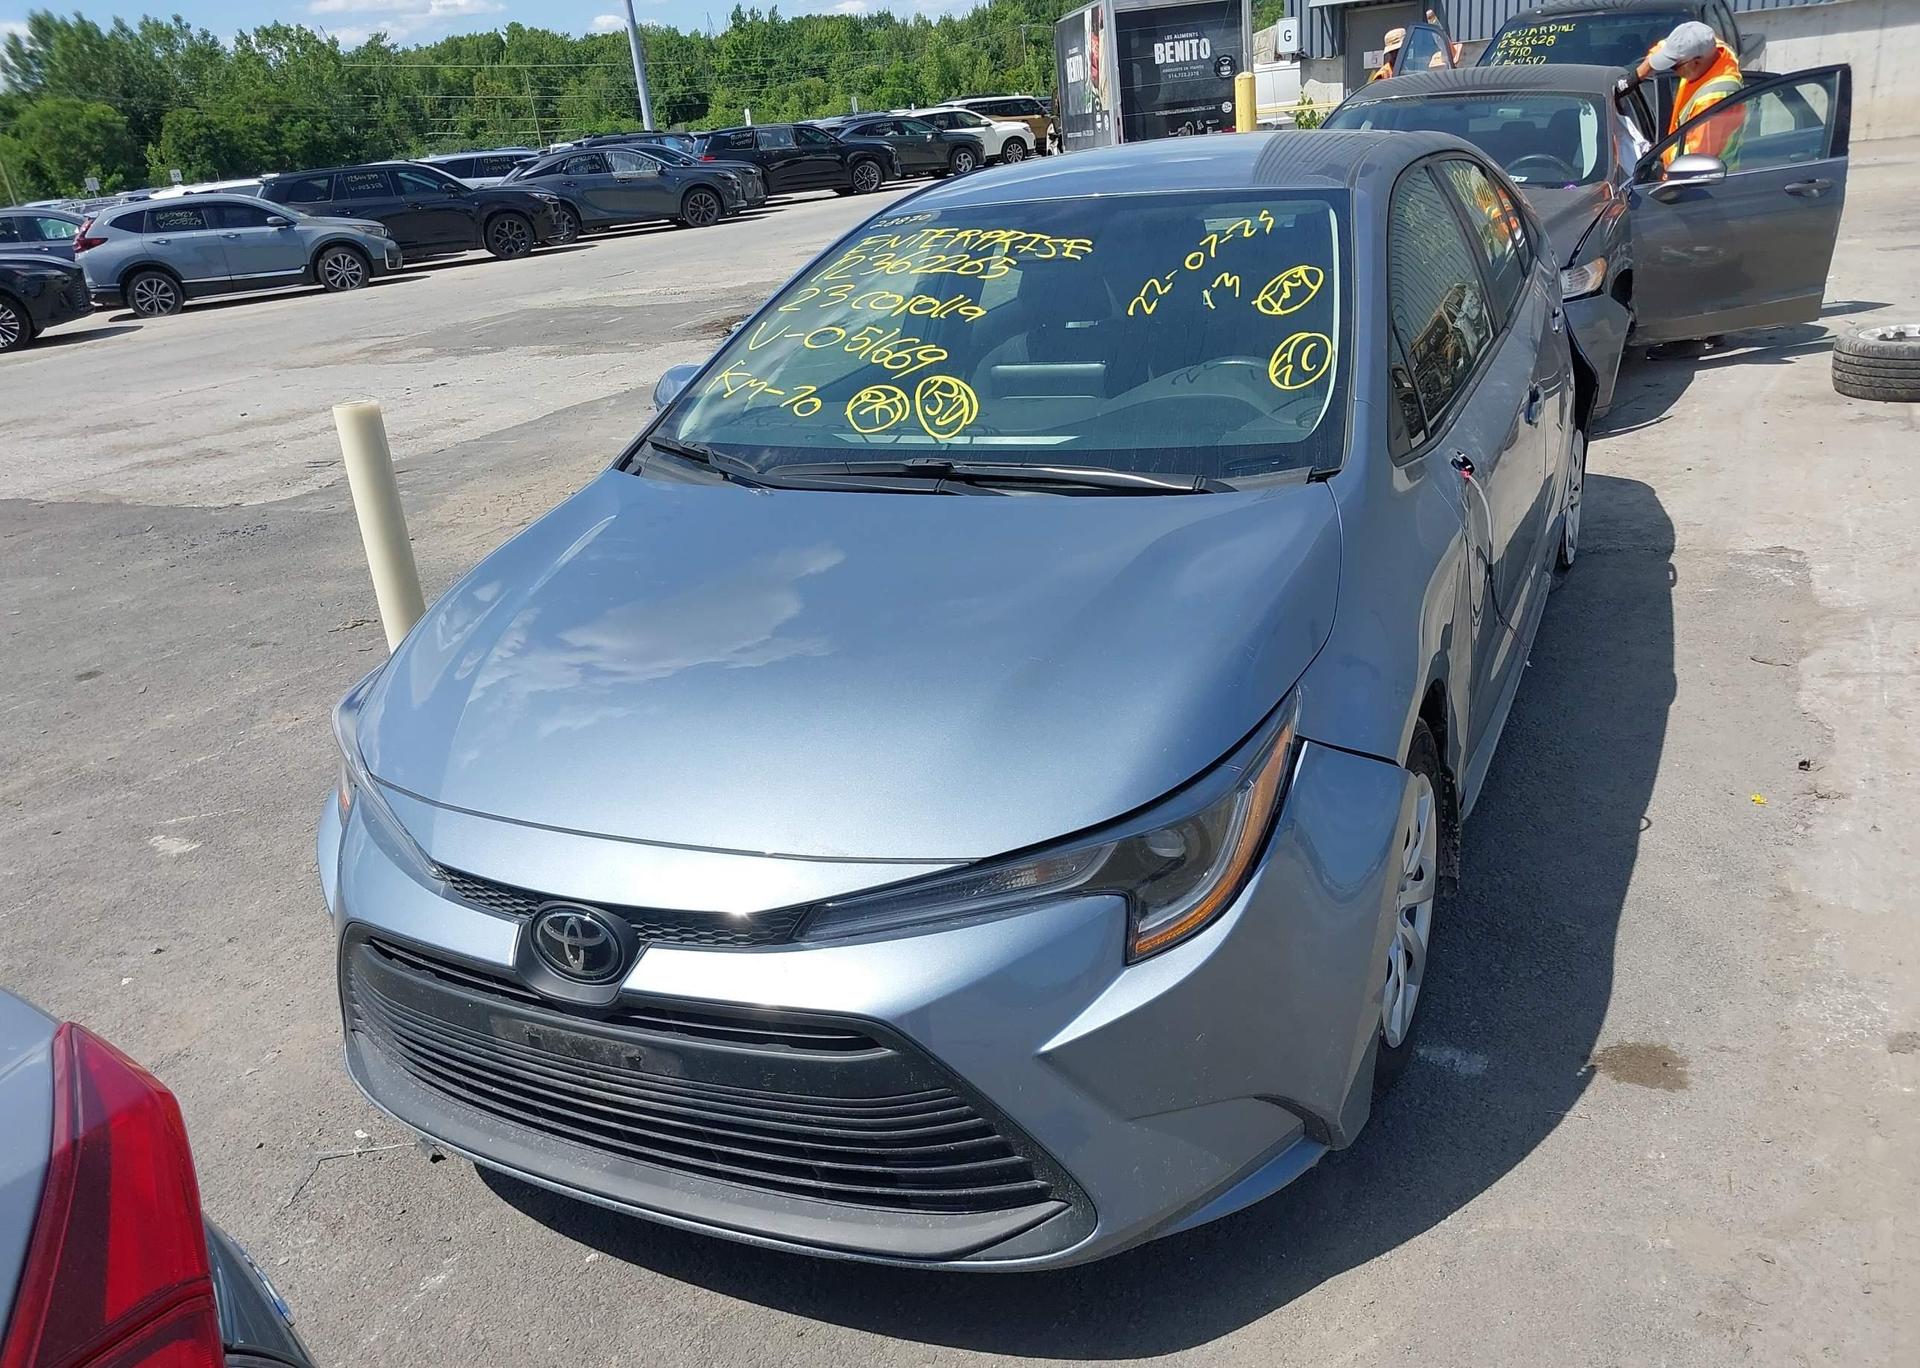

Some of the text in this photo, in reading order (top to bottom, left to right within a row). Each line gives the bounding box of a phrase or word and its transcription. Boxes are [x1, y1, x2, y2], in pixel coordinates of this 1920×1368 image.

[1283, 29, 1292, 42] G
[1154, 38, 1211, 65] BENITO
[849, 227, 1093, 261] ENTERPRISE
[778, 284, 855, 313] 23
